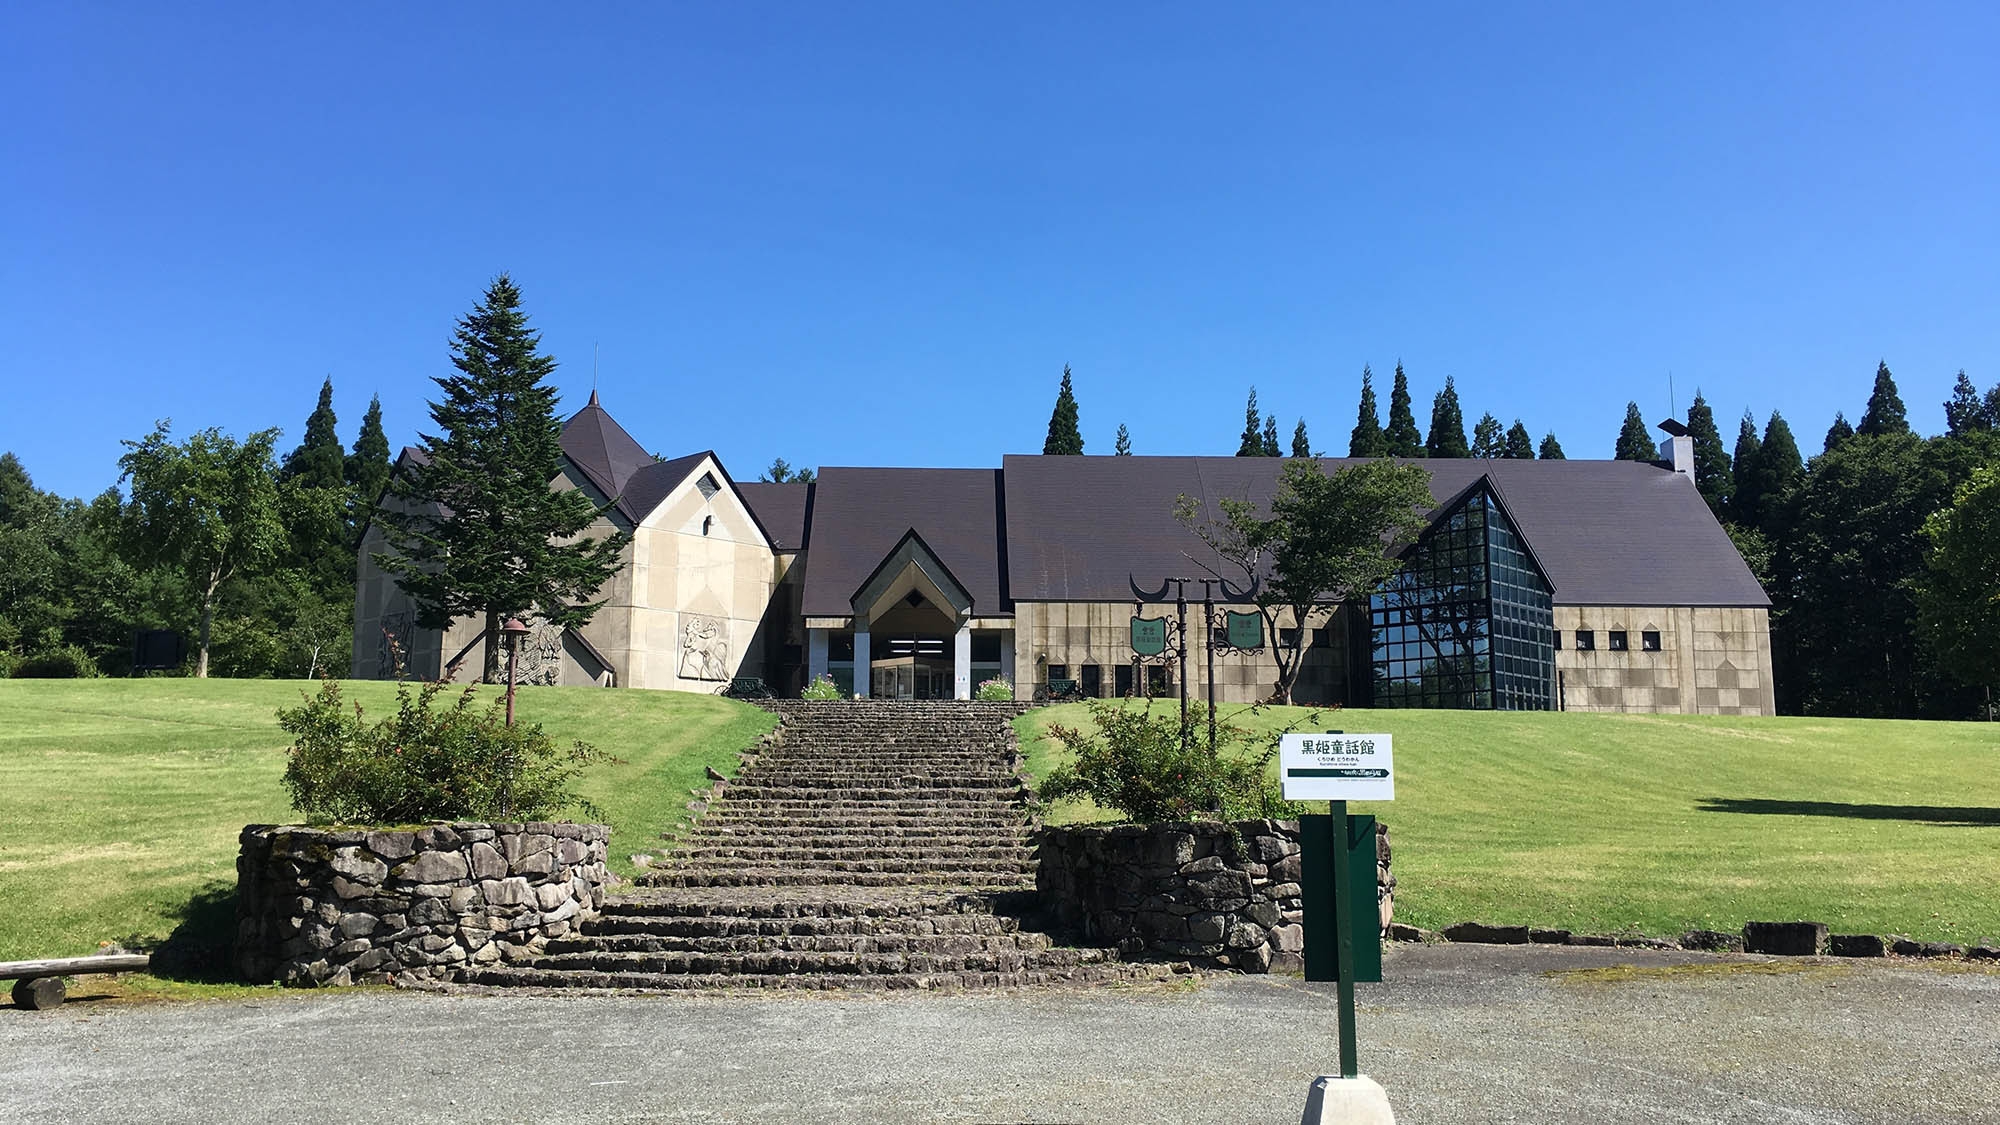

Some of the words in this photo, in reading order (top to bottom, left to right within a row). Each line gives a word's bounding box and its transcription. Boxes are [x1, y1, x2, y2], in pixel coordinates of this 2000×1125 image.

[1301, 739, 1375, 755] 黒姫童話館
